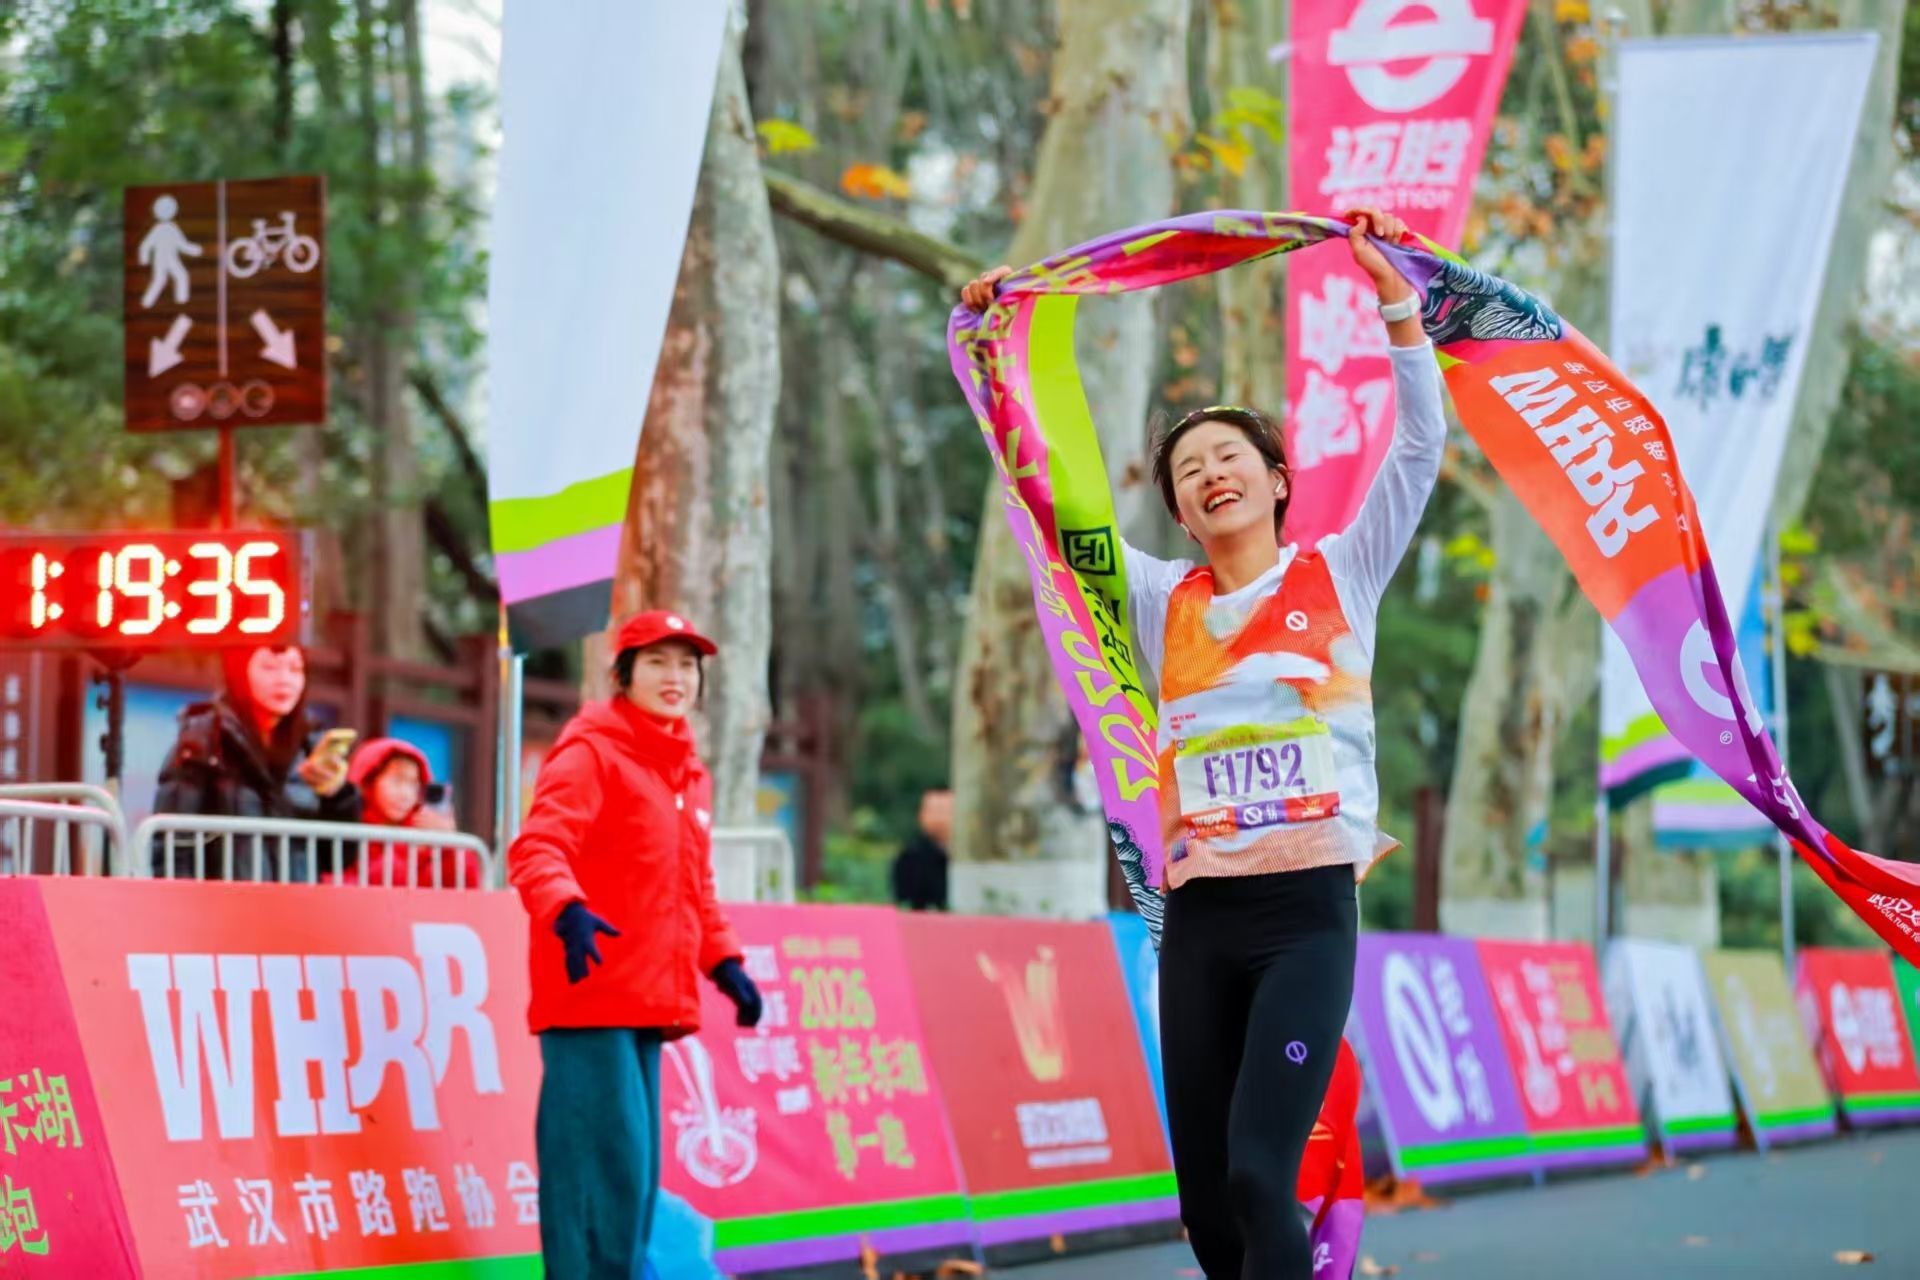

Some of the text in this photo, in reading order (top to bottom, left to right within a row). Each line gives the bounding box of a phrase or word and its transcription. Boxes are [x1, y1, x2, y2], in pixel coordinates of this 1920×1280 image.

[31, 541, 285, 636] 1:19:35
[126, 922, 505, 1142] WHRR
[177, 1160, 540, 1249] 武汉市路跑协会
